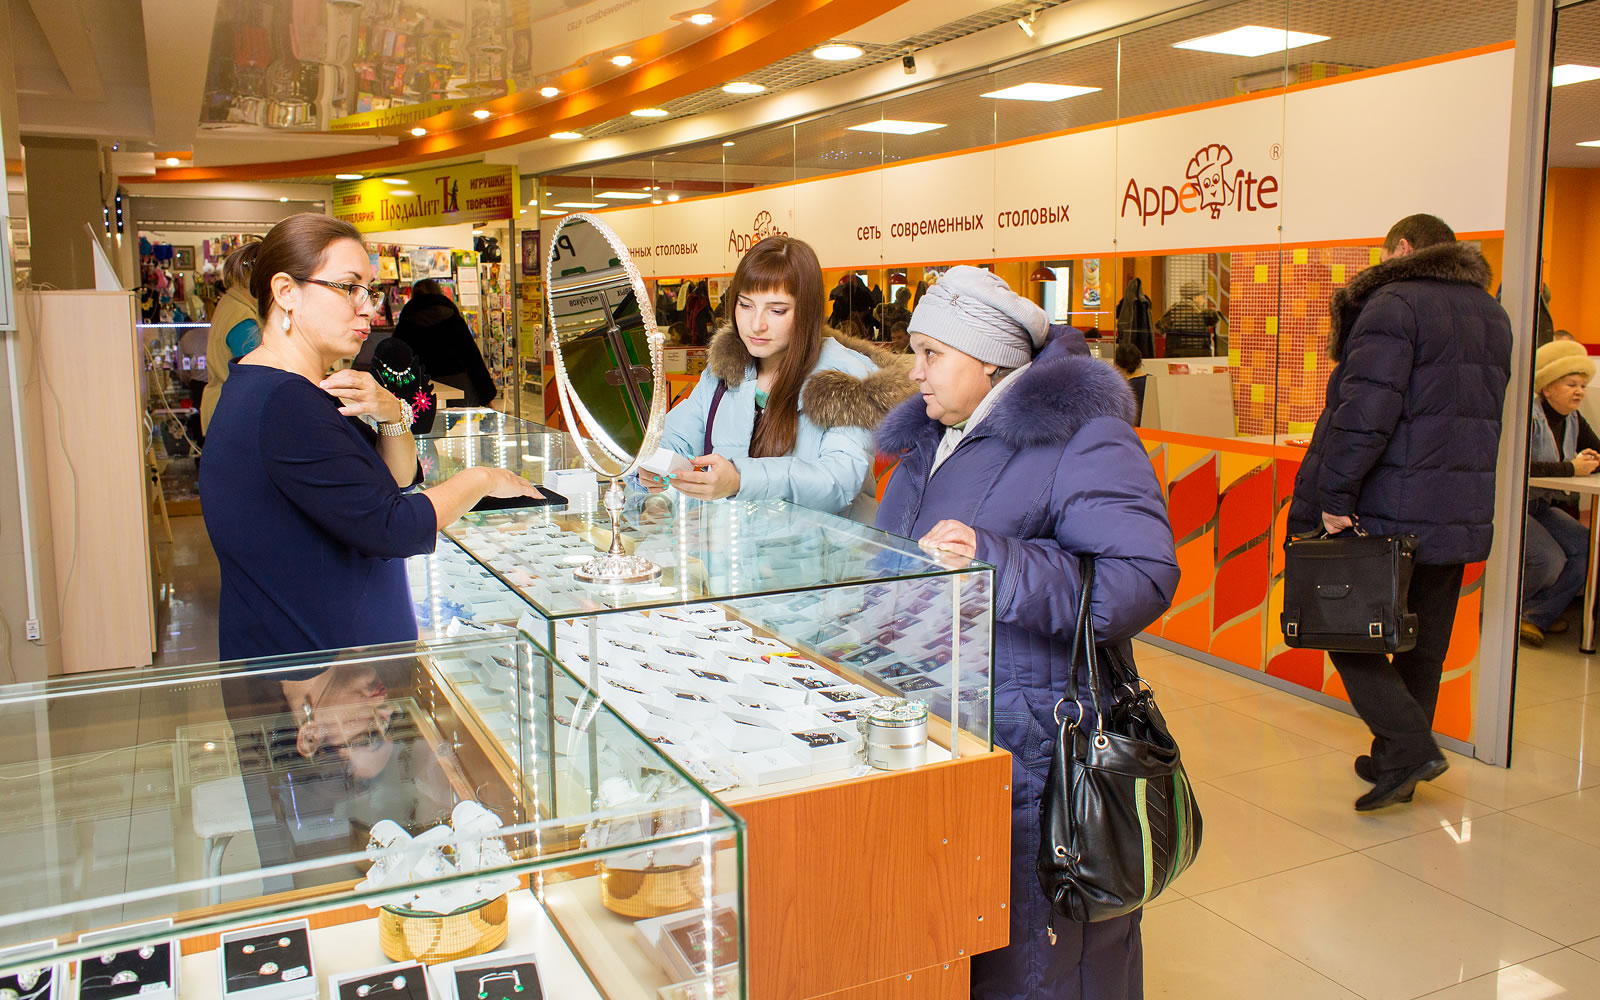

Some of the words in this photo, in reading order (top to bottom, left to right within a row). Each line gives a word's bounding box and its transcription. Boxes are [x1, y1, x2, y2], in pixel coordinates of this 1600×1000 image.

[857, 222, 881, 241] сеть
[890, 213, 984, 243] современных
[997, 204, 1070, 229] столовых
[655, 243, 698, 257] столовых
